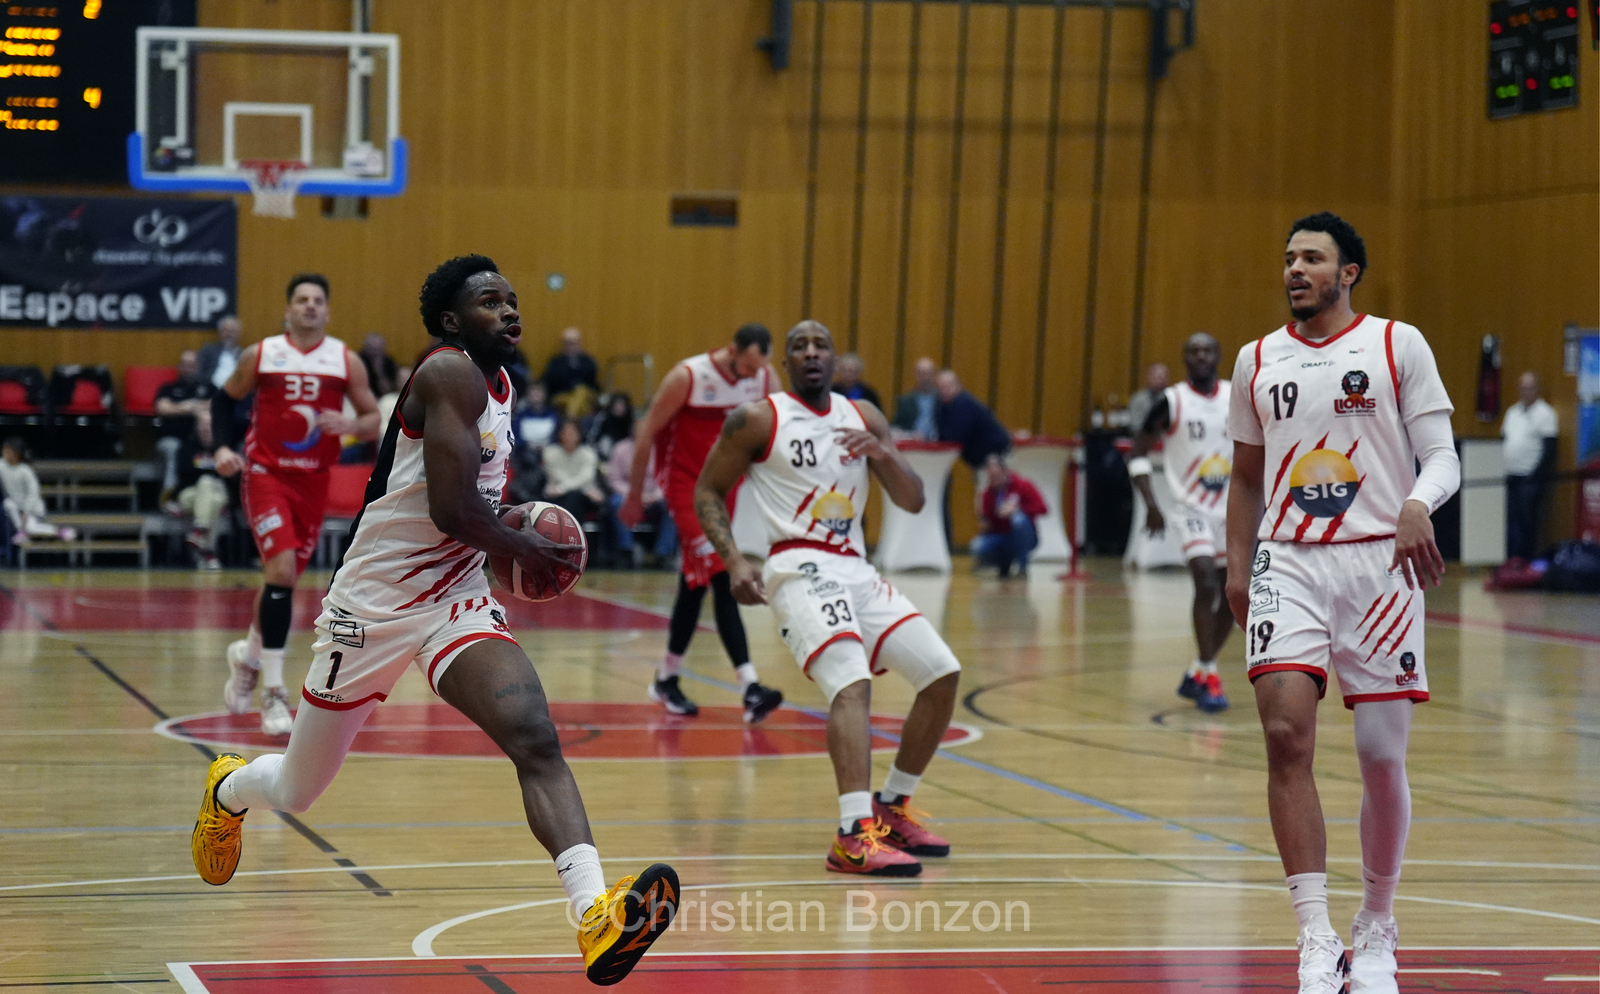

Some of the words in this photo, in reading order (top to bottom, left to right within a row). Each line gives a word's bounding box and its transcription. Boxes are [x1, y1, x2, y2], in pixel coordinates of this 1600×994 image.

[0, 284, 146, 327] Espace
[160, 286, 227, 322] VIP
[284, 375, 320, 401] 33
[1269, 382, 1298, 421] 19
[1333, 398, 1377, 415] LIONS
[790, 439, 817, 468] 33
[1303, 482, 1348, 500] SIG
[822, 599, 852, 627] 33
[1249, 620, 1274, 657] 19
[326, 650, 343, 690] 1
[311, 688, 336, 701] CRAFT
